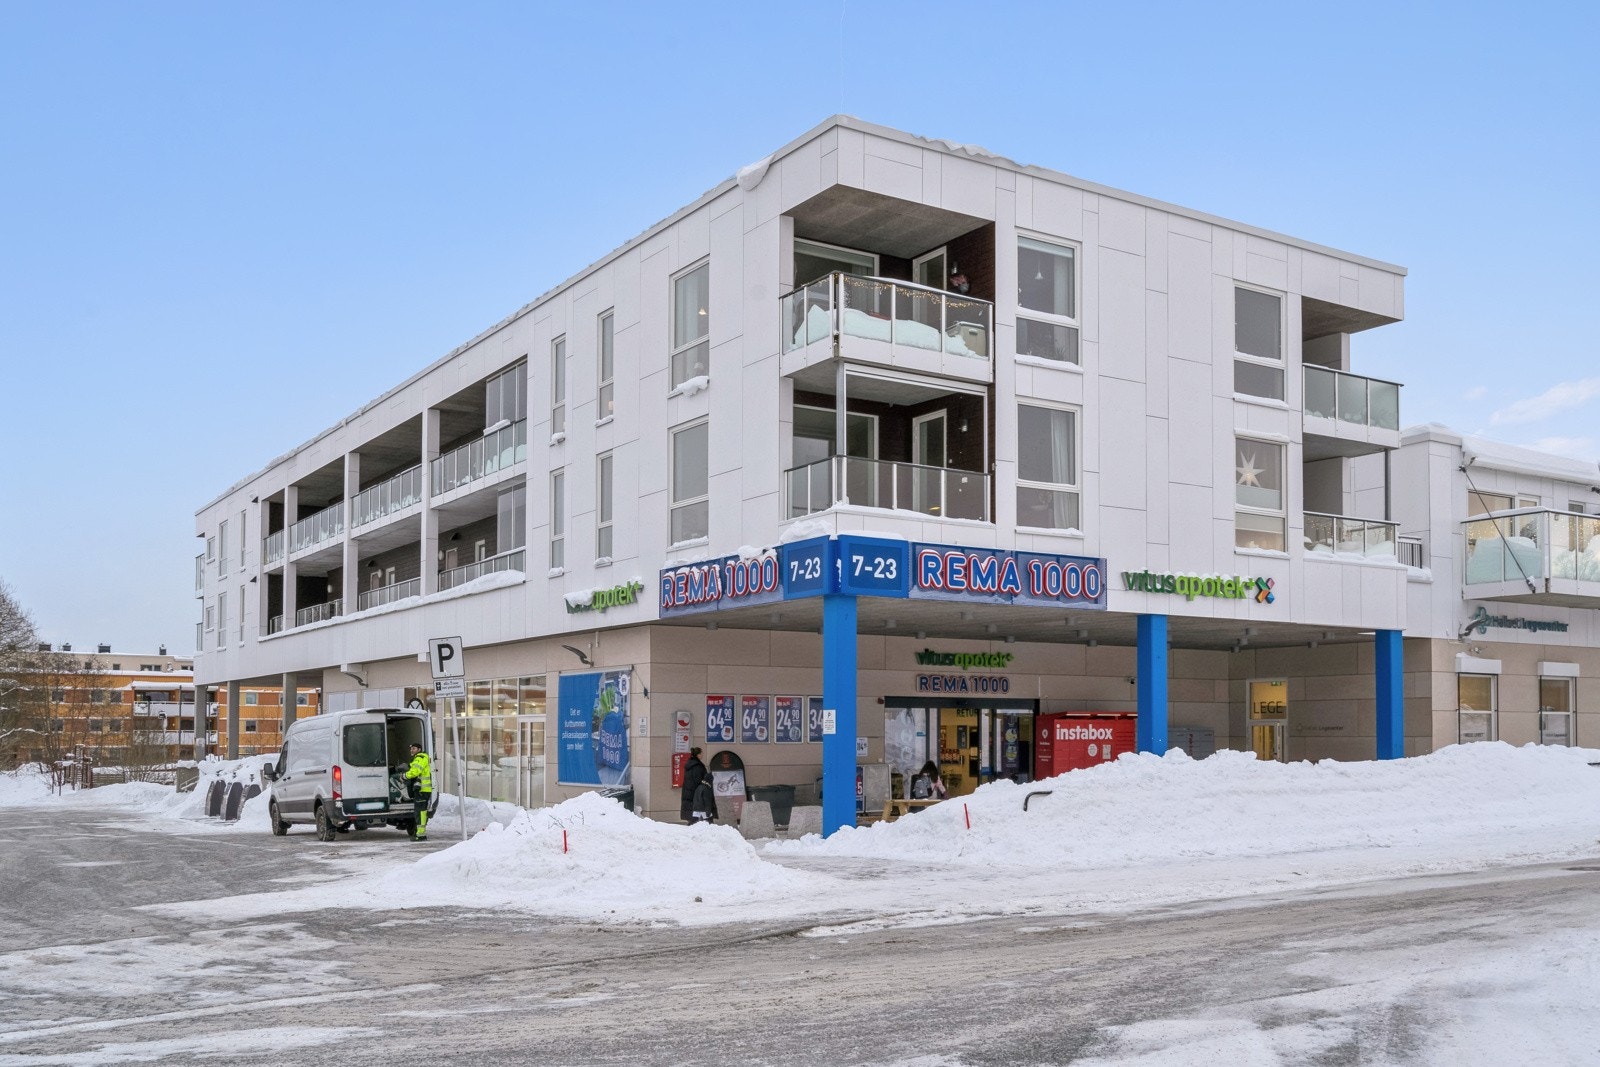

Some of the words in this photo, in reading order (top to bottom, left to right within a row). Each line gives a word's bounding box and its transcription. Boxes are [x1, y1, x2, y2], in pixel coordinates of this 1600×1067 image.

[790, 557, 821, 582] 7-23
[852, 554, 897, 579] 7-23
[918, 548, 1023, 595] REMA
[1029, 559, 1102, 600] 1000
[662, 566, 722, 608] REMA
[726, 555, 779, 597] 1000
[437, 643, 454, 673] P
[917, 676, 969, 693] REMA
[971, 676, 1010, 694] 1000
[1253, 701, 1283, 714] LEGE
[708, 708, 725, 729] 64
[724, 708, 733, 719] 90
[743, 708, 759, 729] 64
[758, 708, 766, 719] 90
[776, 709, 792, 730] 24
[791, 709, 800, 720] 90
[601, 730, 622, 749] REMA
[1056, 724, 1113, 740] instabox
[602, 747, 621, 764] 1000
